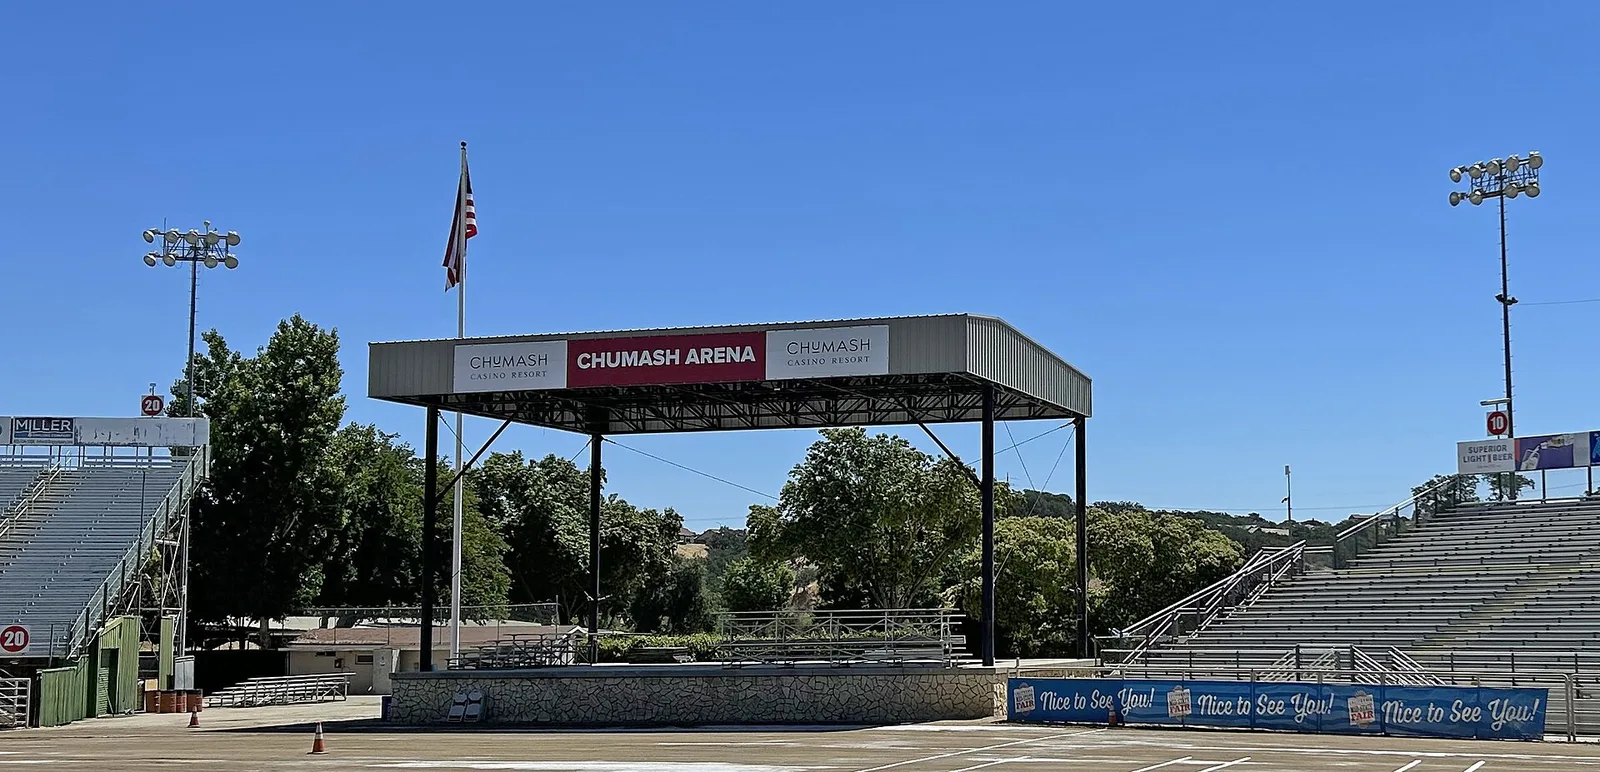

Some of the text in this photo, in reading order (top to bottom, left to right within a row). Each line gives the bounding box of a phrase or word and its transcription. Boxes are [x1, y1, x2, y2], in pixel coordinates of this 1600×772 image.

[786, 338, 870, 355] CHUMASH
[469, 353, 548, 369] CHUMASH
[576, 346, 756, 369] CHUMASH ARENA
[787, 355, 870, 367] CASINO RESORT
[470, 370, 547, 380] CASINO RESORT
[144, 399, 160, 411] 20
[16, 419, 71, 434] MILLER
[1490, 416, 1504, 430] 10
[1468, 445, 1507, 453] SUPERIOR
[1463, 453, 1513, 463] LIGHT BEER
[4, 630, 25, 647] 20
[1016, 700, 1034, 710] FAIR
[1040, 687, 1155, 717] Nice to See You!
[1198, 692, 1335, 724] Nice to See You!
[1170, 705, 1190, 714] FAIR
[1351, 711, 1373, 721] FAIR
[1381, 698, 1541, 732] Nice to See You!
